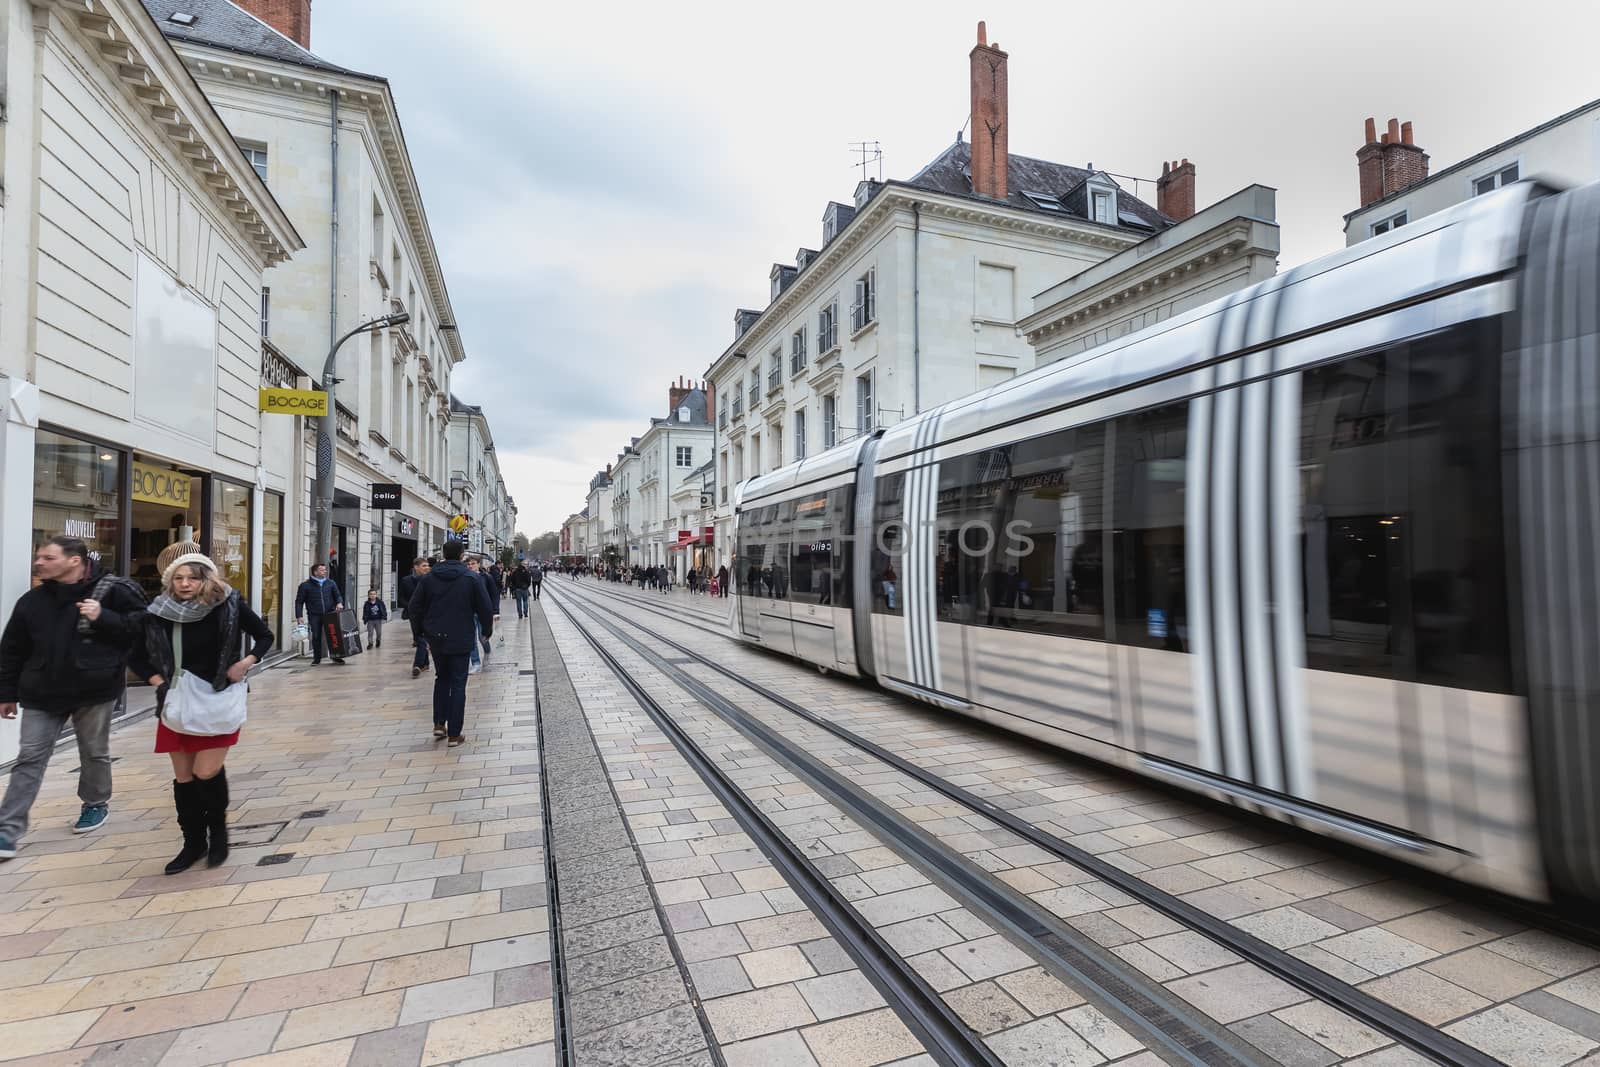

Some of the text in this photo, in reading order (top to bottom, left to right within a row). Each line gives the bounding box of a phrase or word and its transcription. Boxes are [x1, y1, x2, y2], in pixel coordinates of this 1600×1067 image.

[268, 395, 325, 410] BOCAGE
[133, 467, 189, 502] BOCAGE
[65, 519, 96, 539] NOUVELLE
